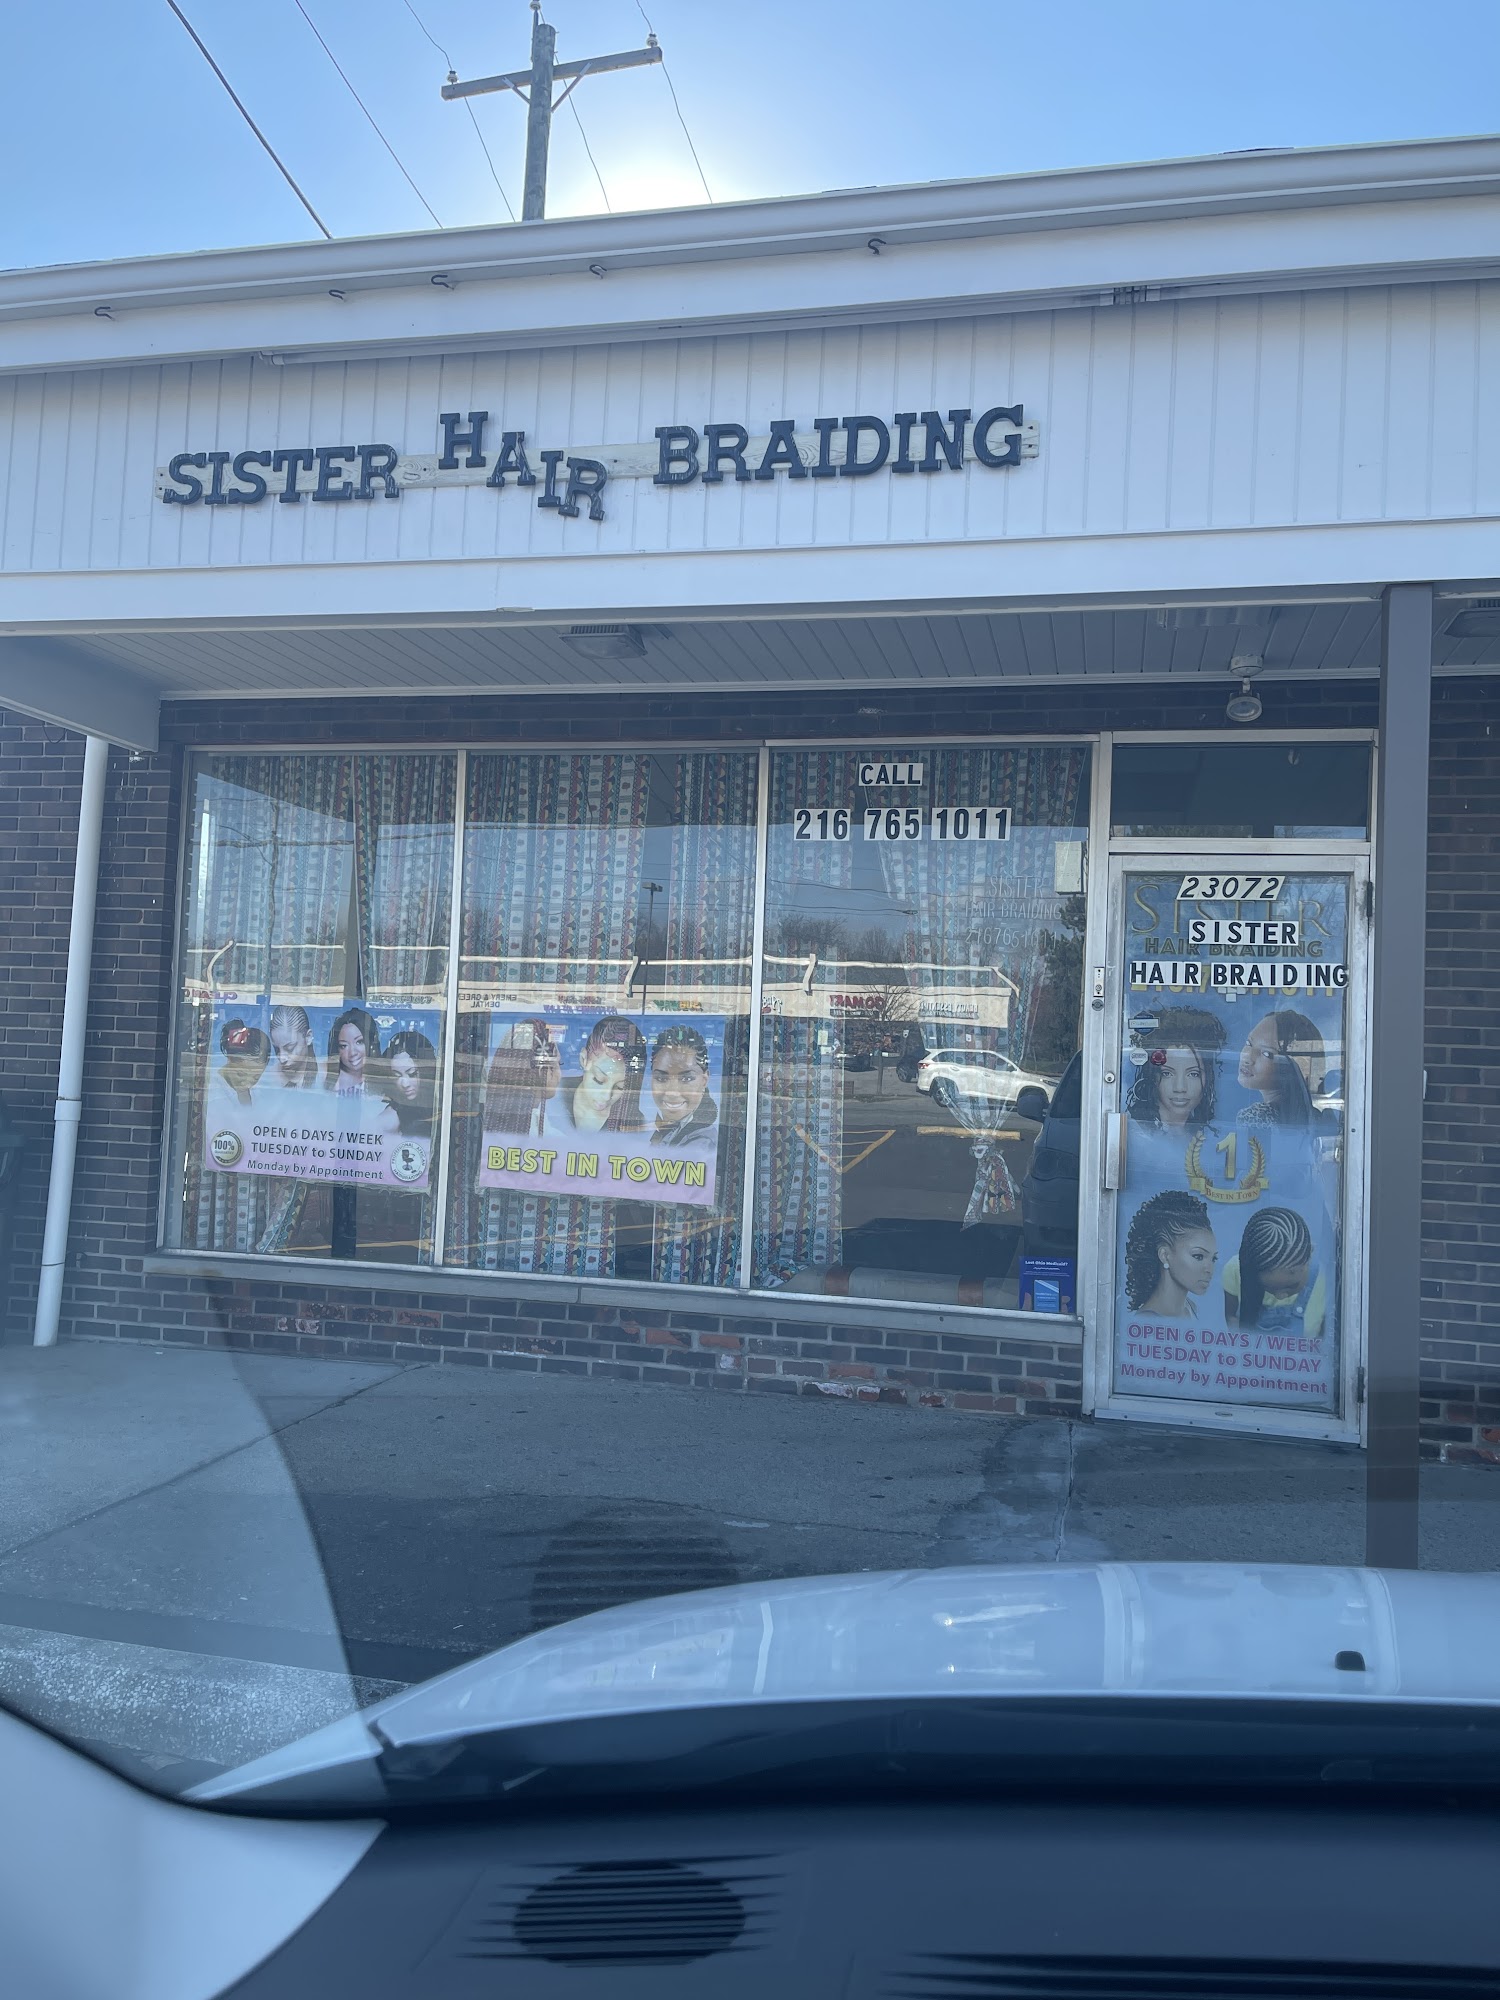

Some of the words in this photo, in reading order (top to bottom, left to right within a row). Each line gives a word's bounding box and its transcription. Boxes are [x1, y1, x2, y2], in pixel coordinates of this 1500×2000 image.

[162, 443, 399, 506] SISTER
[438, 410, 608, 521] HAIR
[653, 404, 1025, 486] BRAIDING
[860, 764, 921, 785] CALL
[795, 809, 849, 840] 216
[866, 808, 920, 840] 765
[936, 808, 1008, 840] 1011
[989, 874, 1043, 898] SISTER
[1180, 876, 1280, 899] 23072
[965, 899, 994, 918] HAIR
[1001, 900, 1062, 920] BRAIDING
[1191, 921, 1297, 944] SISTER
[1131, 962, 1199, 984] HAIR
[1213, 964, 1348, 987] BRAIDING
[213, 1139, 235, 1151] 100%
[253, 1125, 287, 1139] OPEN
[290, 1128, 297, 1139] 6
[301, 1128, 334, 1142] DAYS
[338, 1131, 343, 1142] /
[346, 1132, 383, 1145] WEEK
[251, 1142, 307, 1157] TUESDAY
[312, 1147, 325, 1158] to
[329, 1148, 383, 1162] SUNDAY
[1216, 1132, 1236, 1180] 1
[247, 1159, 290, 1174] Monday
[293, 1162, 306, 1175] by
[309, 1164, 384, 1180] Appointment
[487, 1146, 557, 1174] BEST
[566, 1152, 599, 1178] IN
[608, 1156, 706, 1187] TOWN
[1128, 1324, 1179, 1342] OPEN
[1185, 1329, 1195, 1343] 6
[1201, 1330, 1250, 1348] DAYS
[1256, 1334, 1262, 1349] /
[1267, 1336, 1321, 1353] WEEK
[1127, 1343, 1211, 1364] TUESDAY
[1217, 1353, 1236, 1366] to
[1242, 1353, 1321, 1373] SUNDAY
[1121, 1363, 1185, 1384] Monday
[1191, 1369, 1210, 1386] by
[1216, 1372, 1327, 1394] Appointment
